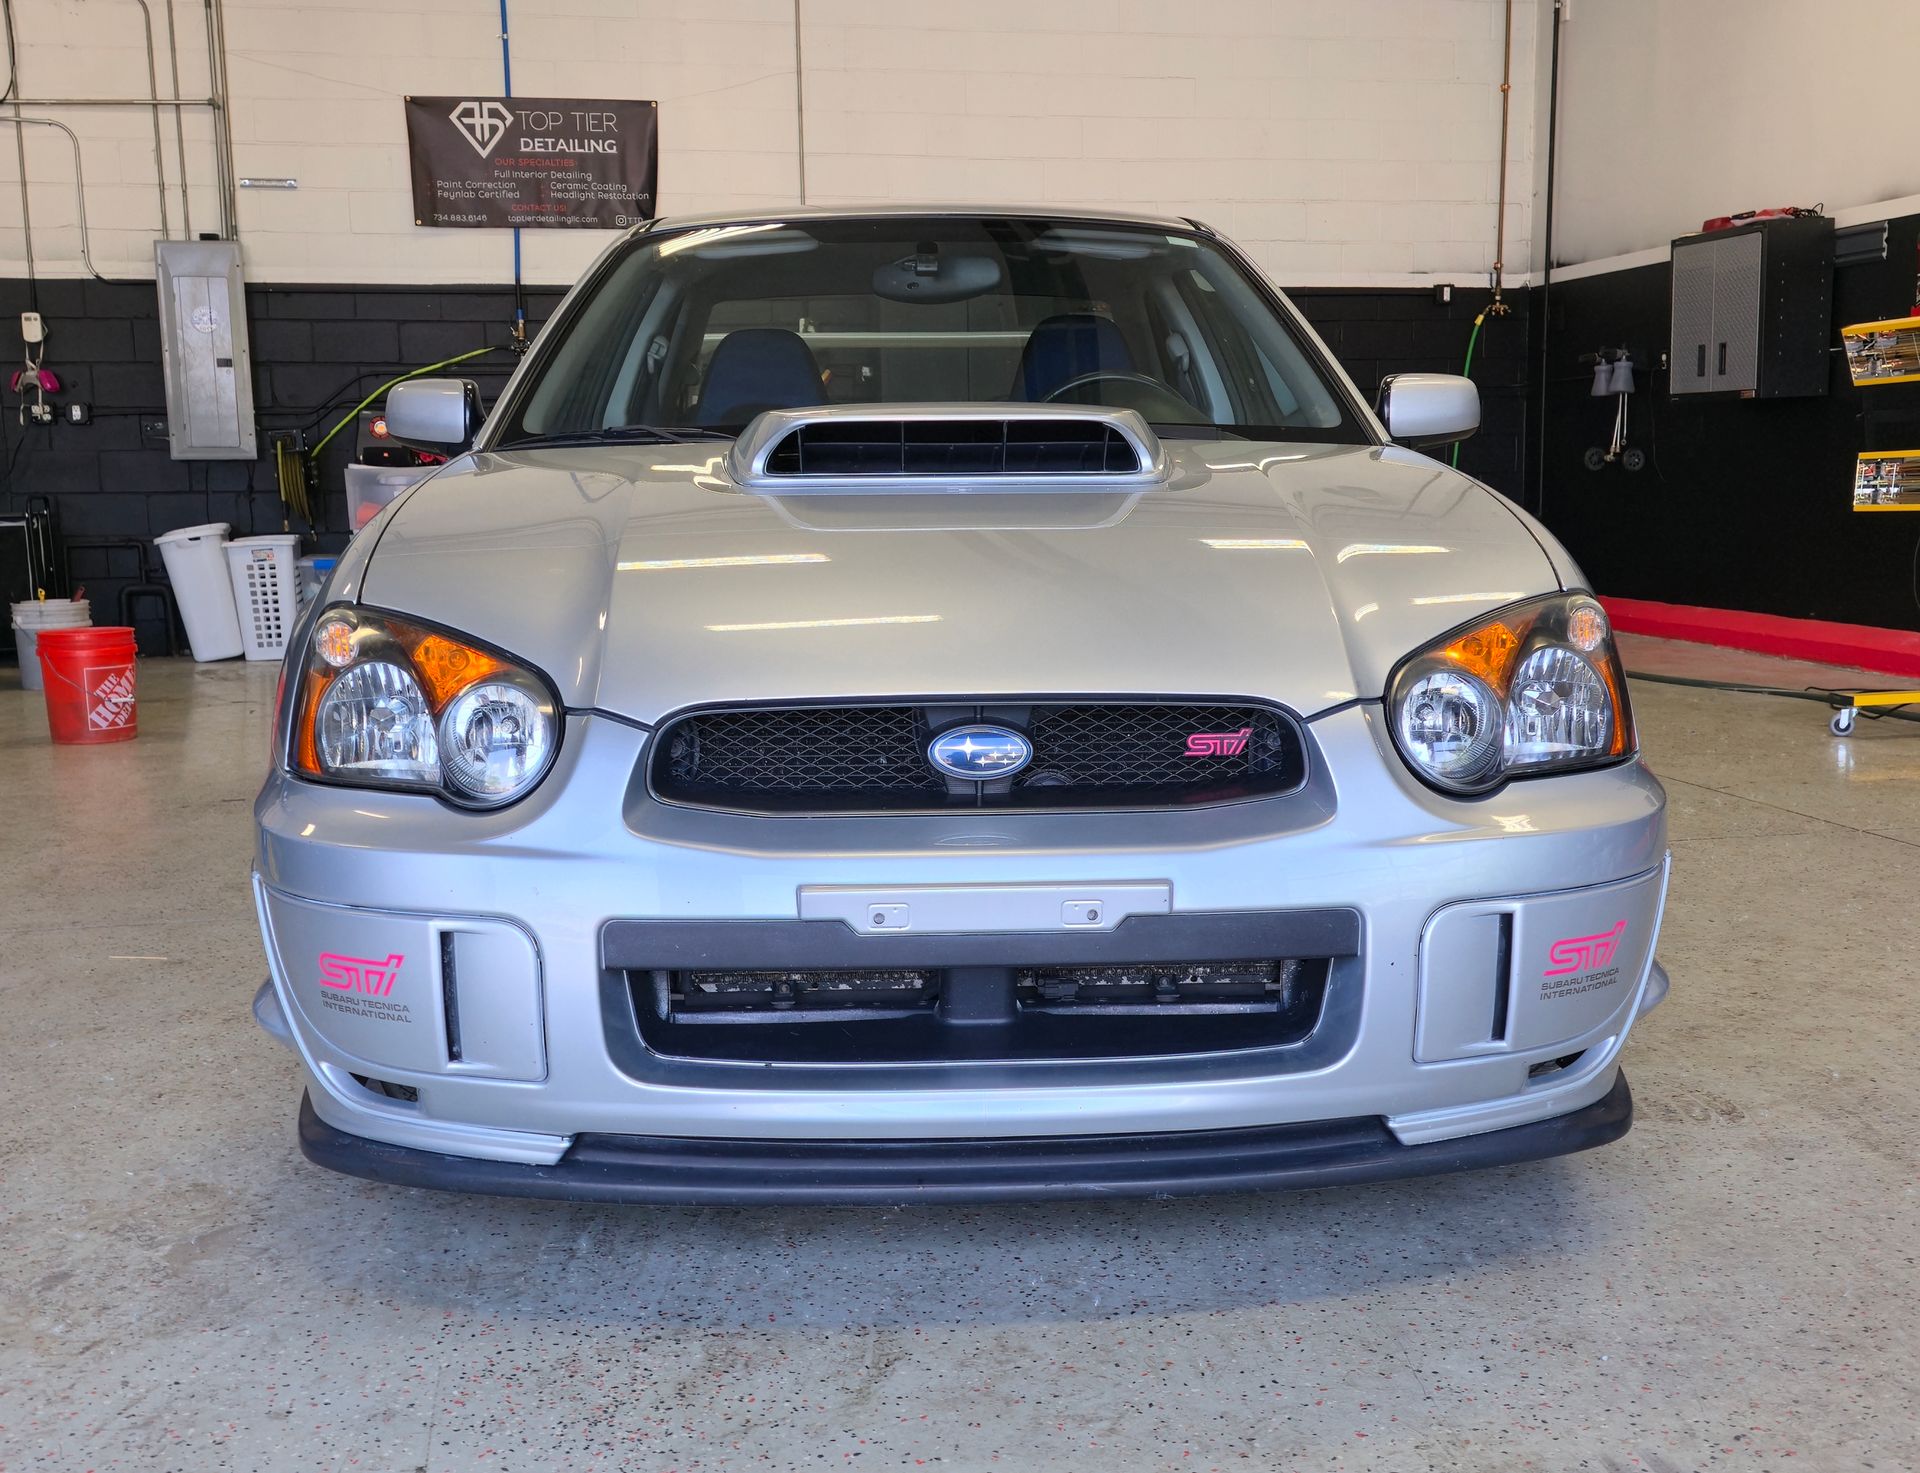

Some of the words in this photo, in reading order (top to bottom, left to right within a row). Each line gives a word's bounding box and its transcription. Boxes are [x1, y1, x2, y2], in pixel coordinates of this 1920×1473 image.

[516, 110, 563, 131] TOP
[570, 111, 618, 133] TIER
[519, 137, 618, 154] DETAILING
[495, 158, 515, 167] OUR
[494, 170, 511, 179] Full
[512, 170, 547, 179] Interior
[550, 171, 592, 182] Detailing
[436, 180, 463, 189] Paint
[465, 180, 516, 189] Correction
[550, 181, 589, 191] Ceramic
[590, 182, 627, 193] Coating
[437, 190, 476, 200] Feynlab
[478, 190, 520, 199] Certified
[550, 191, 596, 201] Headlight
[511, 203, 552, 212] CONTACT
[433, 213, 488, 222] 734.883.6146
[507, 214, 598, 225] toptierdetailingllc.com
[93, 673, 120, 700] THE
[1541, 976, 1584, 992] SUBARU
[1585, 967, 1620, 983] TECNICA
[1540, 977, 1618, 1001] INTERNATIONAL
[320, 990, 360, 1006] SUBARU
[361, 1000, 410, 1013] TECNICA
[322, 1000, 413, 1023] INTERNATIONAL
